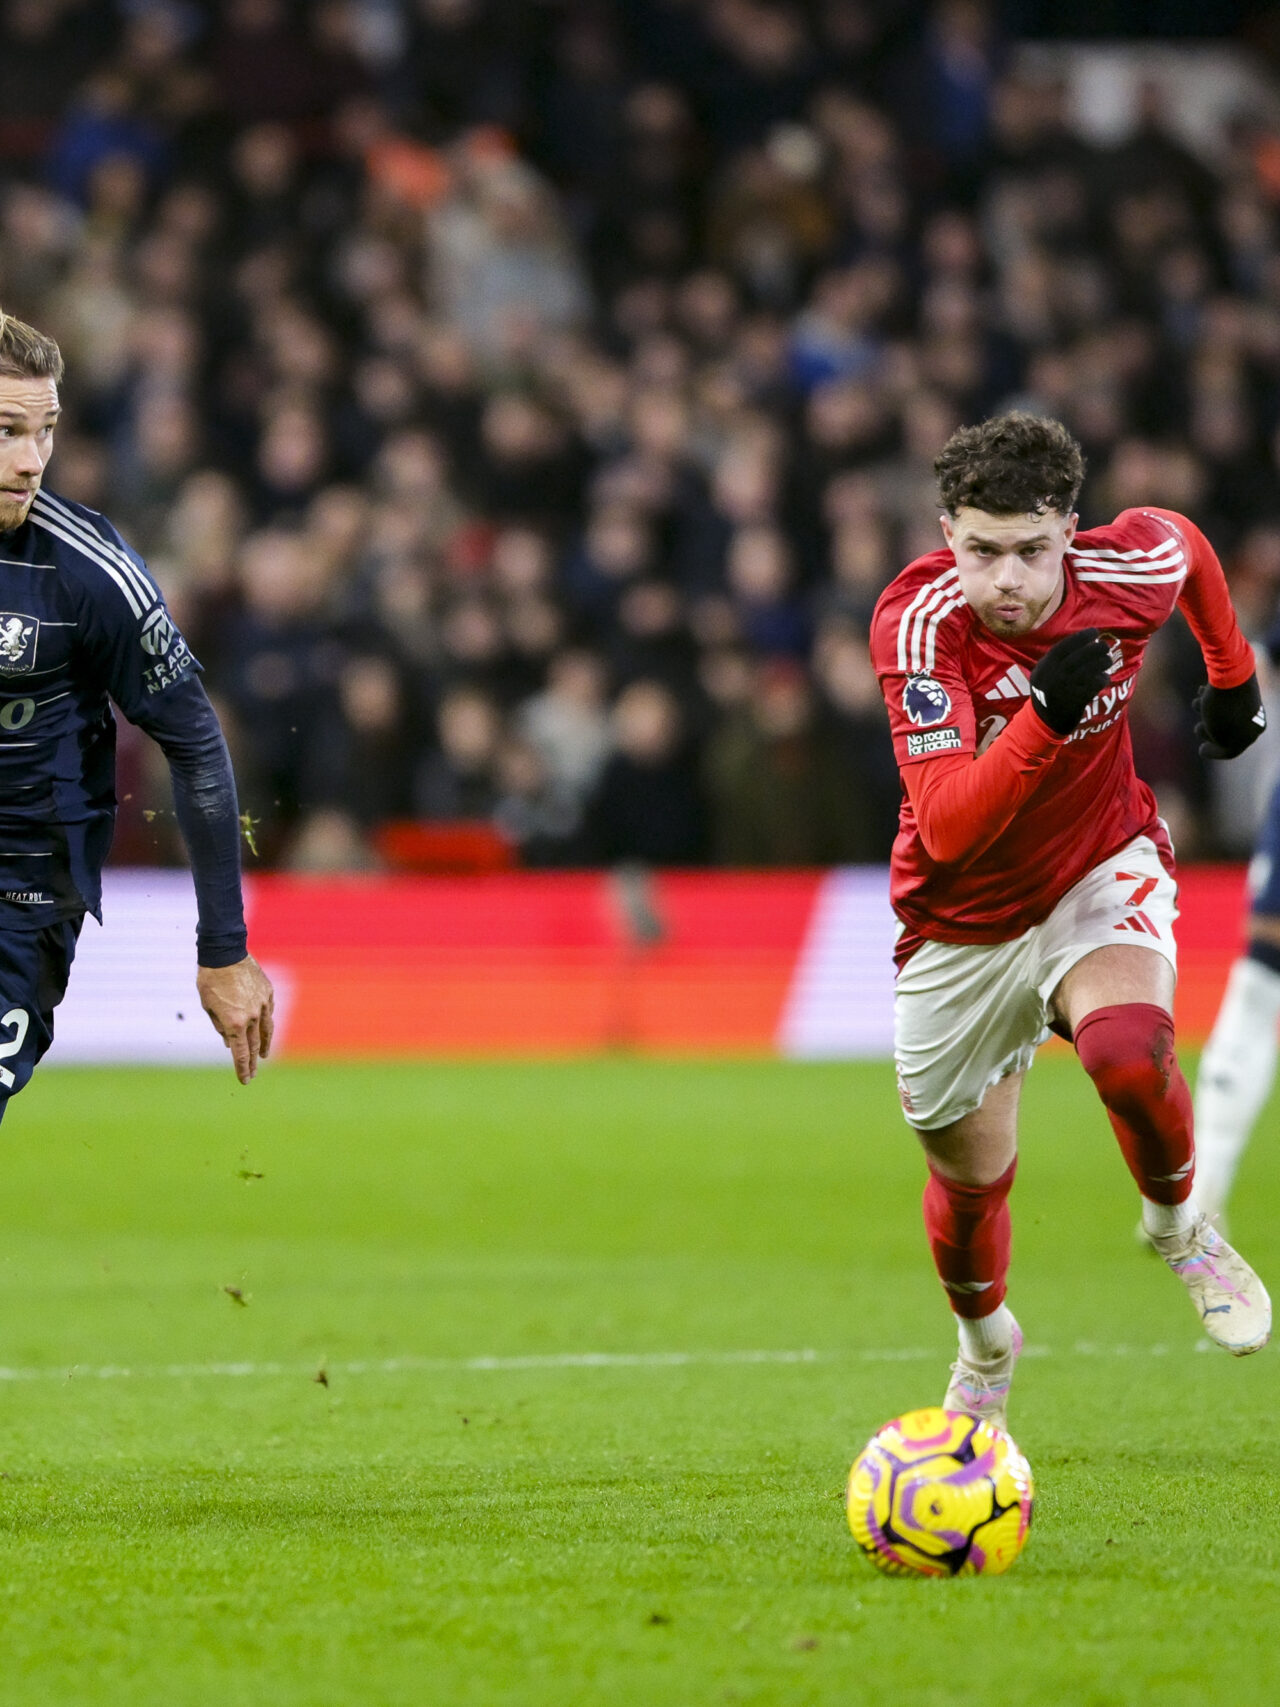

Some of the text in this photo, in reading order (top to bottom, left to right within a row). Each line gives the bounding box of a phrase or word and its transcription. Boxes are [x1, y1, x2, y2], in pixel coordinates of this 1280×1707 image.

[142, 637, 186, 681] TRAD
[146, 655, 191, 695] NATIO
[907, 729, 956, 747] No room
[923, 738, 962, 753] racism
[1115, 871, 1159, 907] 7
